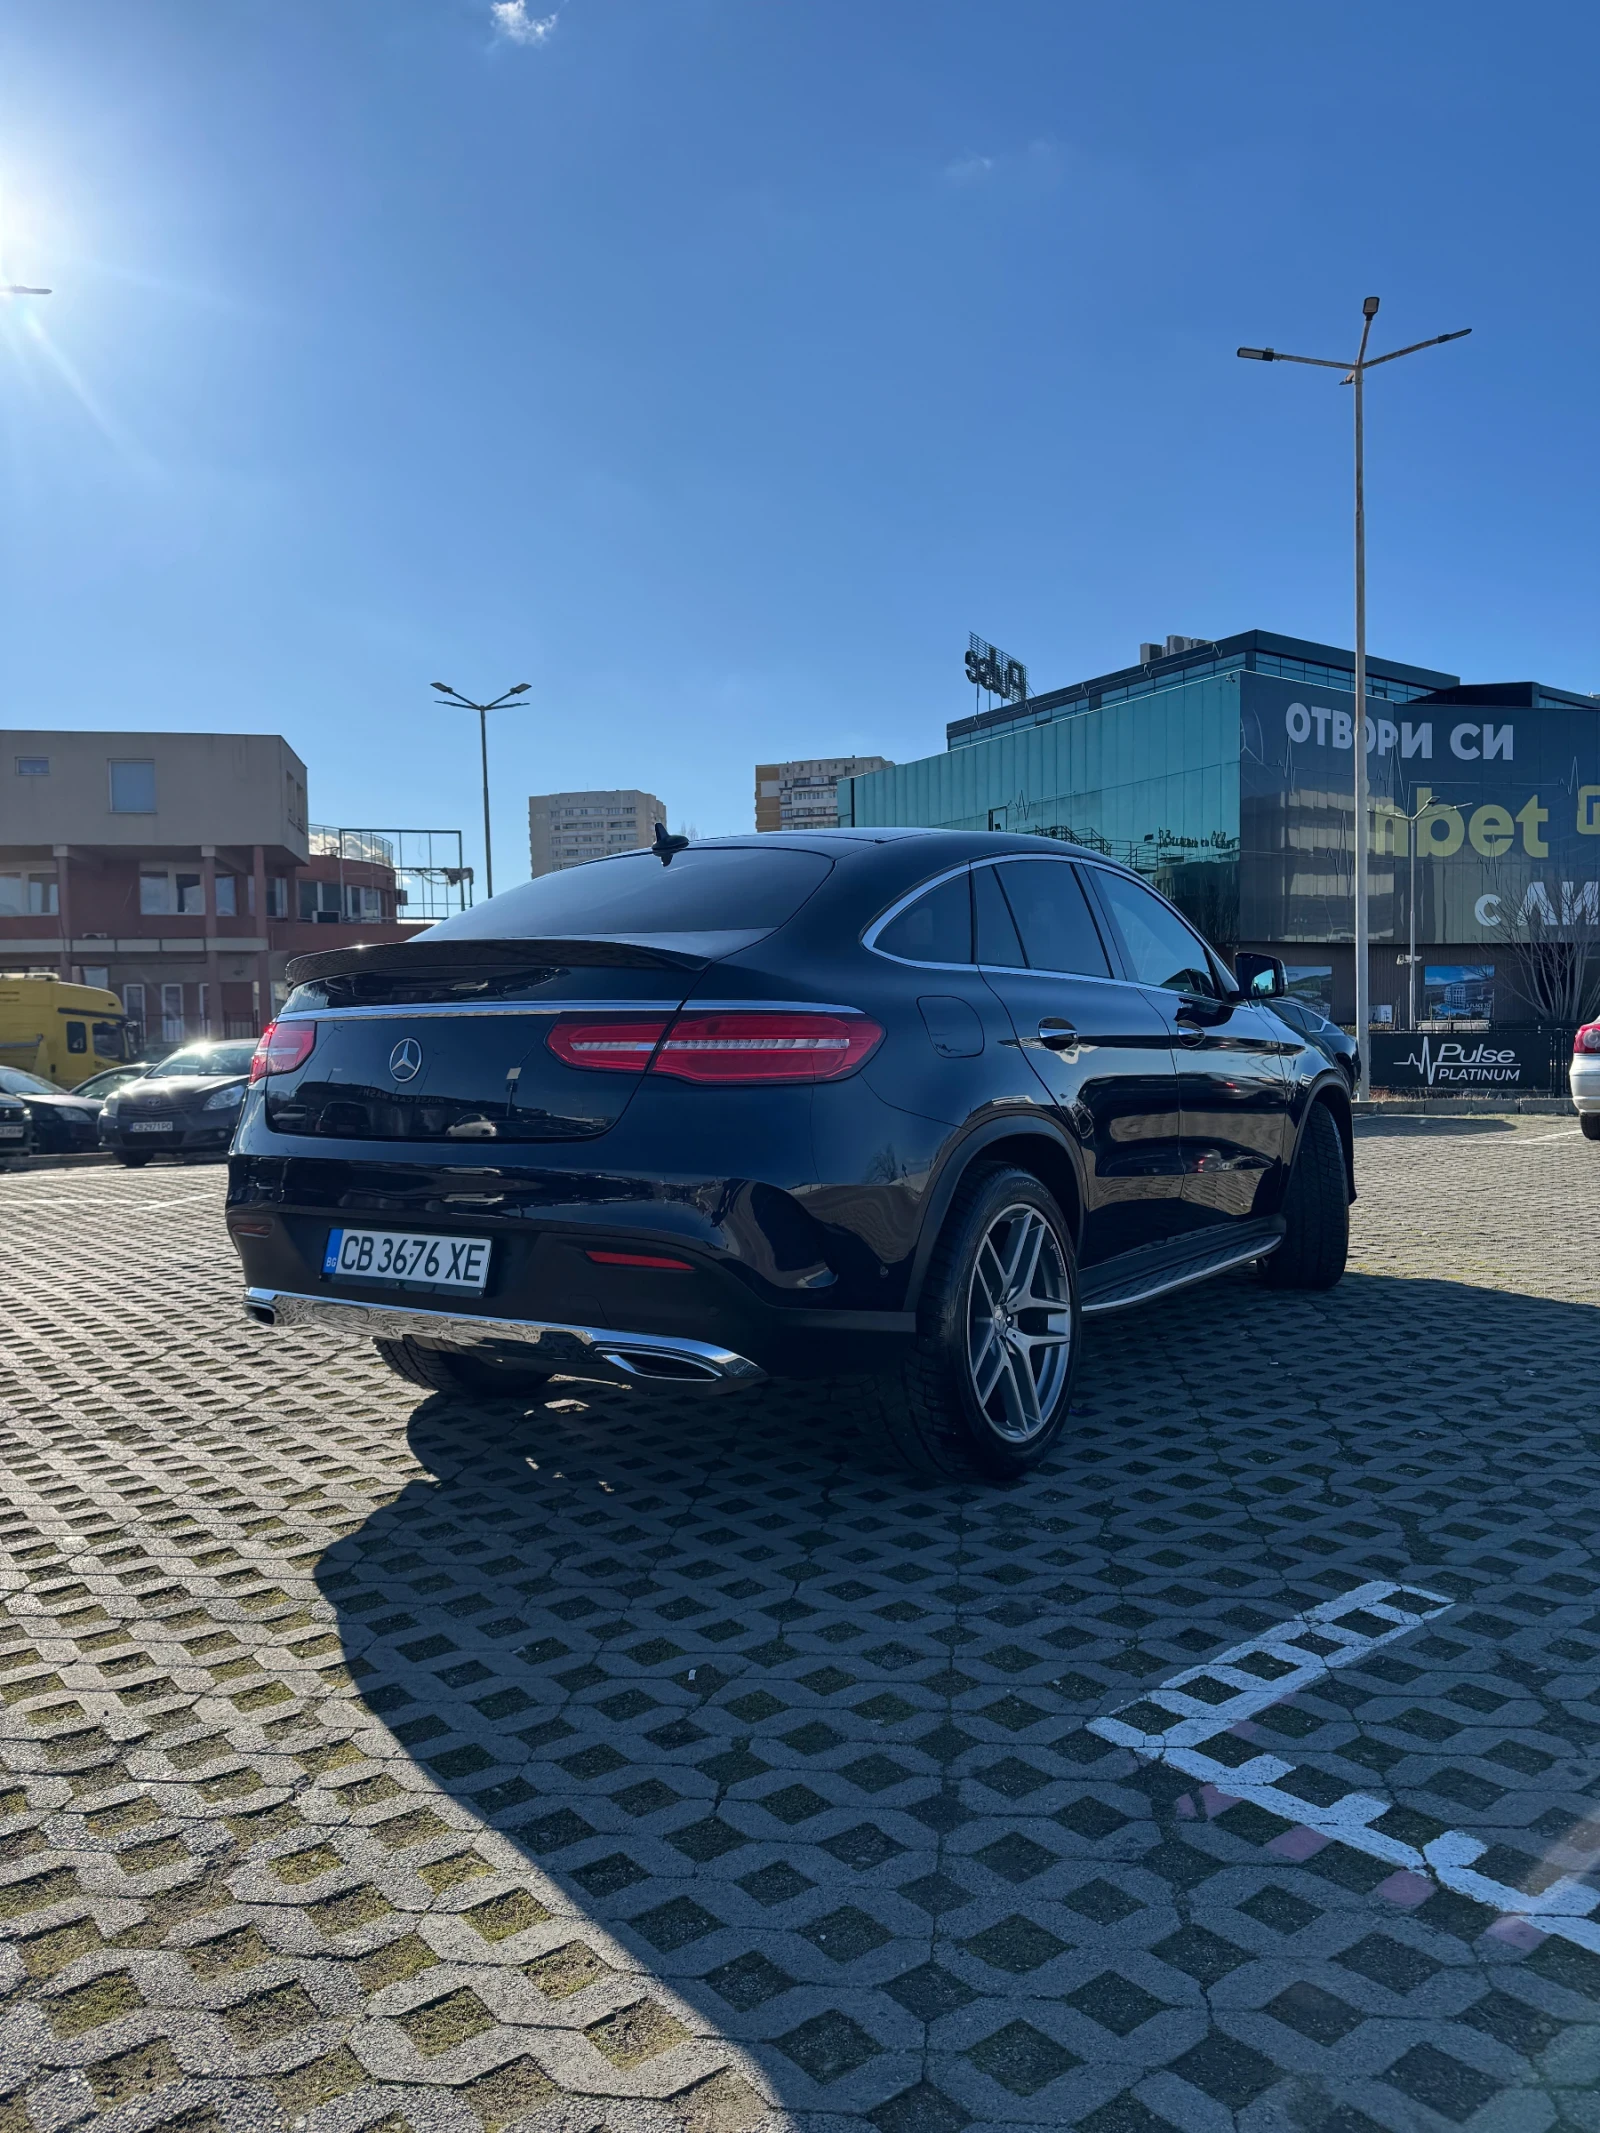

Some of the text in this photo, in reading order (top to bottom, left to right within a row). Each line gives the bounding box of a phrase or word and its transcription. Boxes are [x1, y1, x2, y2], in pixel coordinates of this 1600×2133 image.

[1450, 723, 1514, 761] СИ
[1437, 1044, 1515, 1063] Pulse
[1438, 1068, 1520, 1081] PLATINUM
[326, 1256, 337, 1267] BG
[377, 1238, 440, 1277] 3676
